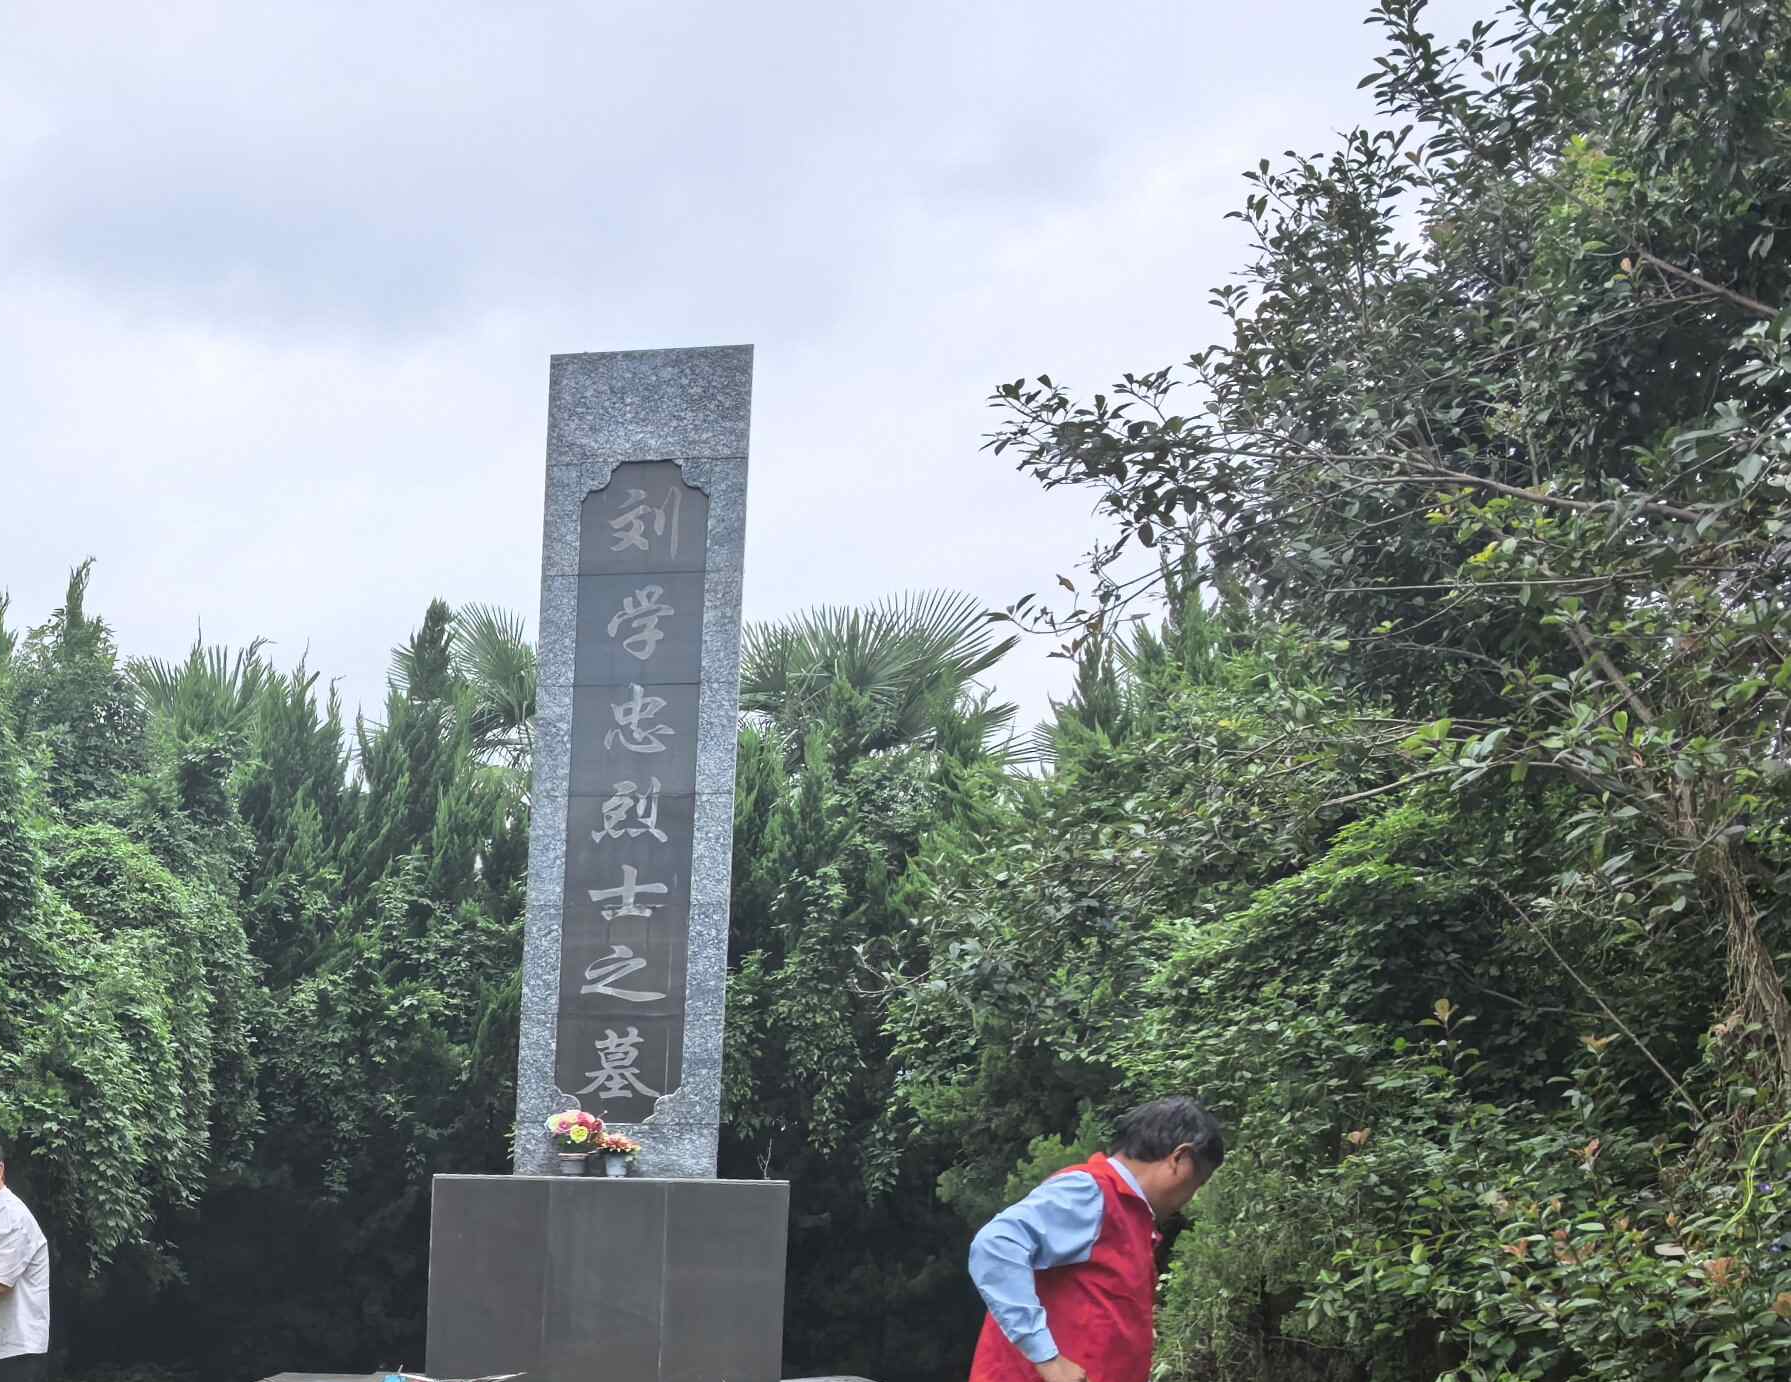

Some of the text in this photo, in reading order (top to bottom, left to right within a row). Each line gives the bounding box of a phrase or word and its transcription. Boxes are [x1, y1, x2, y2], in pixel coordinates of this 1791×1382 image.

[576, 486, 683, 1099] 刘学忠烈士之墓
